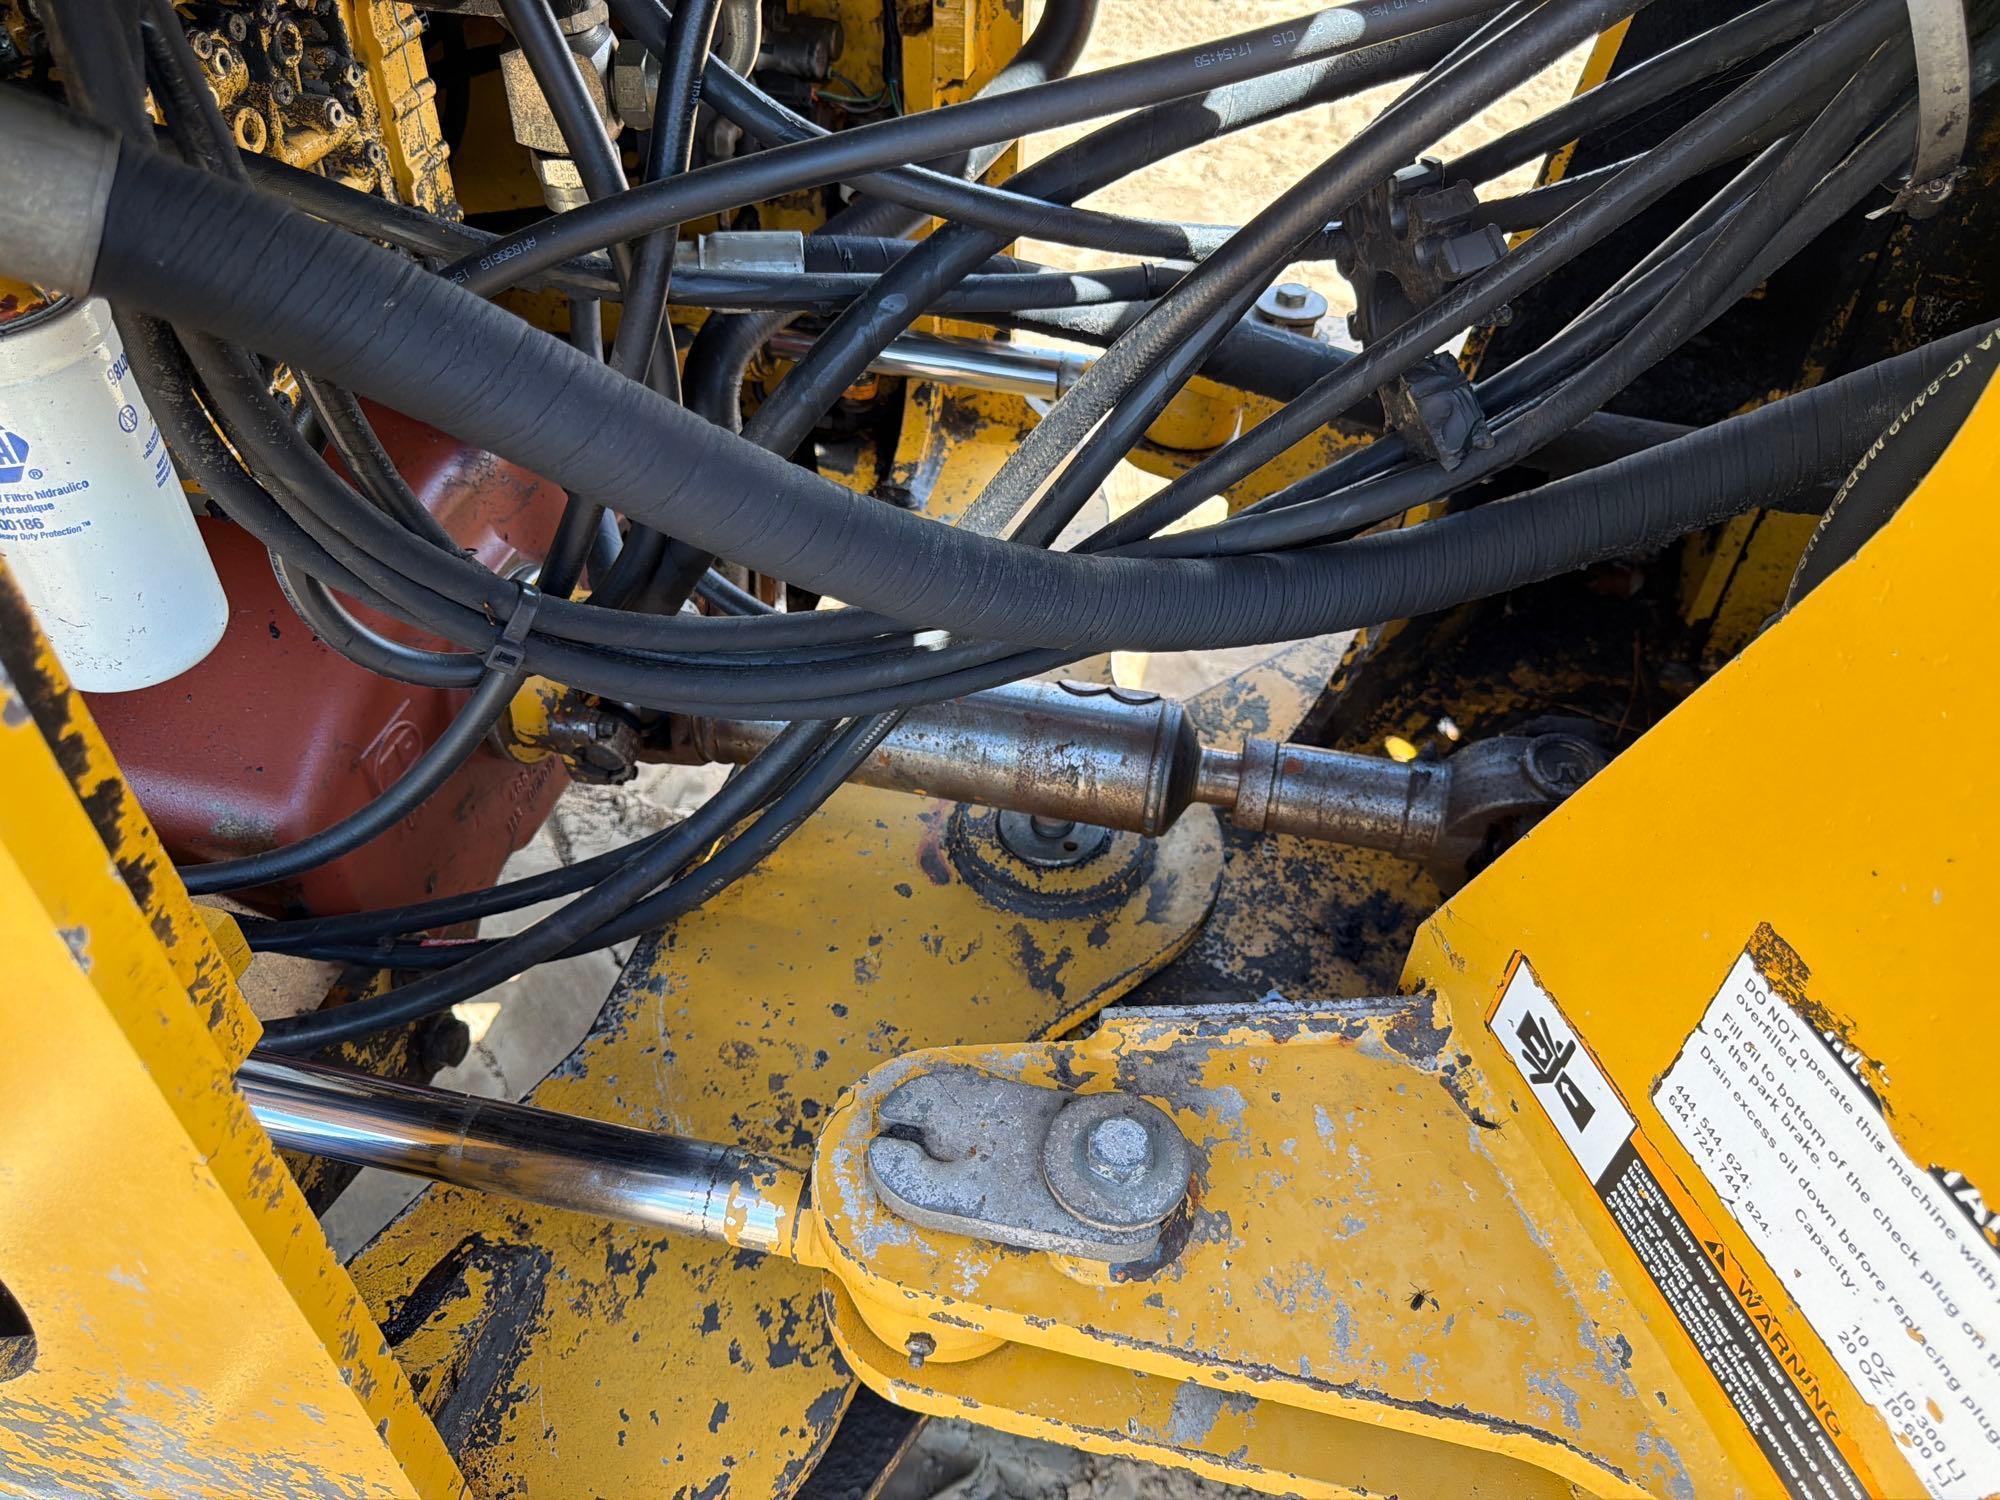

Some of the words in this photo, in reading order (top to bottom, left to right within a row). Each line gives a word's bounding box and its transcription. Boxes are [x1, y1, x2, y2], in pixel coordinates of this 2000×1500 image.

[4, 493, 34, 503] Filtro
[20, 531, 39, 541] Duty
[1819, 508, 1836, 531] IN
[1836, 436, 1885, 505] MADE
[1713, 1027, 1729, 1044] of
[1728, 1044, 1748, 1072] the
[1748, 1073, 1779, 1112] park
[1780, 1111, 1820, 1169] brake.
[1736, 993, 1797, 1073] overfilled.
[1744, 977, 1766, 1005] DO
[1766, 1005, 1800, 1043] NOT
[1799, 1048, 1853, 1114] operate
[1855, 1116, 1886, 1153] this
[1887, 1156, 1956, 1240] machine
[1961, 1245, 1996, 1289] with
[1672, 1085, 1696, 1117] 444,
[1699, 1117, 1722, 1152] 544,
[1726, 1152, 1752, 1189] 624:
[1852, 1325, 1869, 1347] 10
[1871, 1352, 1895, 1388] OZ.
[1895, 1390, 1946, 1453] [0.300
[1945, 1457, 1967, 1482] L]
[1700, 1045, 1731, 1089] Drain
[1733, 1091, 1776, 1148] excess
[1779, 1151, 1798, 1174] oil
[1798, 1177, 1836, 1227] down
[1838, 1228, 1885, 1291] before
[1721, 1012, 1743, 1040] Fill
[1743, 1041, 1761, 1063] oil
[1761, 1063, 1775, 1082] to
[1776, 1082, 1826, 1147] bottom
[1828, 1150, 1847, 1169] of
[1846, 1171, 1870, 1203] the
[1873, 1207, 1920, 1266] check
[1919, 1270, 1959, 1317] plug
[1795, 1208, 1859, 1295] Capacity:
[1605, 1196, 1616, 1209] of
[1614, 1210, 1649, 1262] machine
[1649, 1264, 1660, 1277] or
[1659, 1279, 1713, 1360] transporting
[1712, 1361, 1726, 1380] on
[1724, 1382, 1733, 1392] a
[1732, 1393, 1759, 1435] truck.
[1610, 1190, 1637, 1229] Attach
[1637, 1229, 1668, 1277] locking
[1667, 1276, 1684, 1299] bar
[1682, 1300, 1712, 1345] before
[1711, 1347, 1762, 1421] performing
[1761, 1425, 1799, 1478] service
[1616, 1182, 1644, 1223] engine
[1644, 1225, 1655, 1238] or
[1654, 1240, 1687, 1289] moving
[1686, 1289, 1724, 1345] steering
[1723, 1345, 1753, 1391] wheel.
[1621, 1174, 1643, 1208] Make
[1643, 1209, 1663, 1237] sure
[1661, 1238, 1693, 1282] people
[1692, 1284, 1709, 1306] are
[1708, 1307, 1733, 1341] clear
[1732, 1343, 1746, 1360] of
[1742, 1360, 1785, 1422] machine
[1783, 1422, 1819, 1472] before
[1630, 1159, 1671, 1217] Crushing
[1670, 1215, 1697, 1253] injury
[1696, 1255, 1718, 1284] may
[1716, 1286, 1745, 1327] result
[1744, 1326, 1756, 1342] in
[1754, 1342, 1784, 1385] hinge
[1783, 1387, 1808, 1420] area
[1806, 1420, 1819, 1433] if
[1815, 1434, 1863, 1500] machine
[1668, 1094, 1689, 1128] 644,
[1693, 1127, 1714, 1163] 724,
[1718, 1162, 1741, 1200] 744,
[1745, 1200, 1771, 1238] 824:
[1837, 1331, 1857, 1354] 20
[1859, 1359, 1882, 1395] OZ.
[1931, 1463, 1952, 1488] L]
